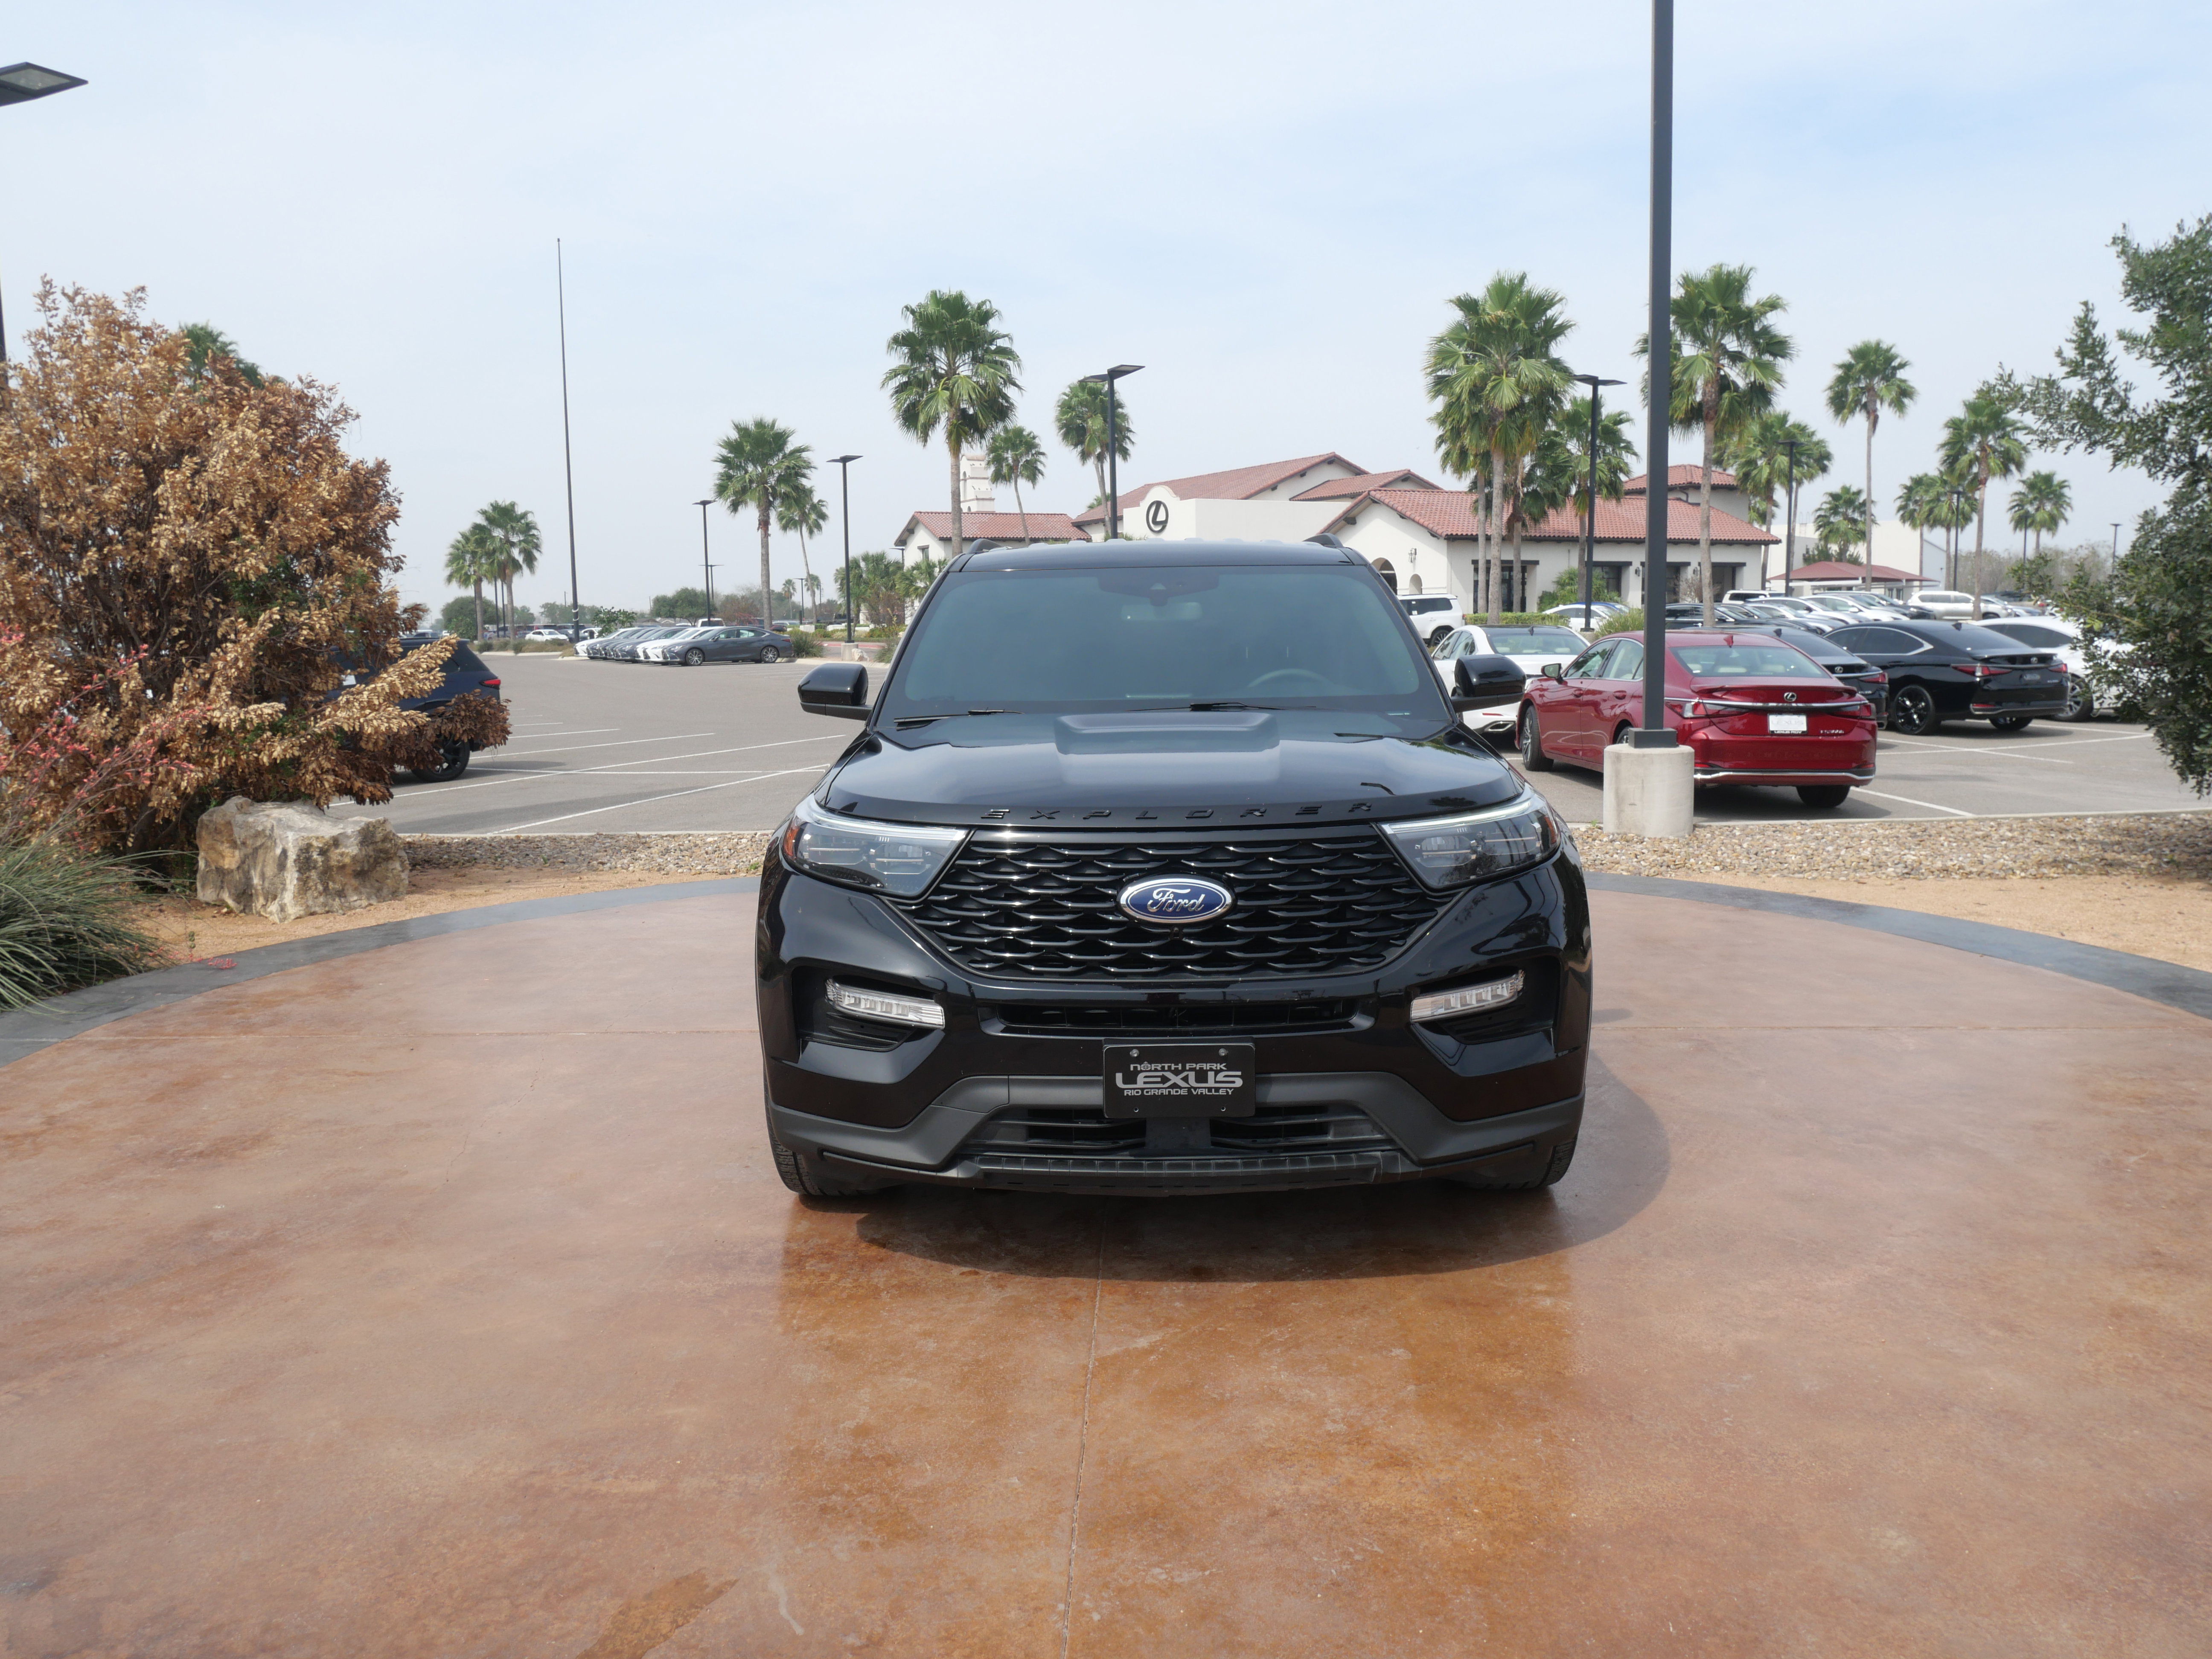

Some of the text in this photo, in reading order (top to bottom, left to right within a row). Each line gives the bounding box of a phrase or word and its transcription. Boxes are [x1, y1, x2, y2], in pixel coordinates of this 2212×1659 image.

[981, 802, 1373, 819] EXPLORER
[1147, 888, 1205, 912] Ford
[1130, 1062, 1182, 1071] NORTH
[1115, 1071, 1243, 1089] LEXUS
